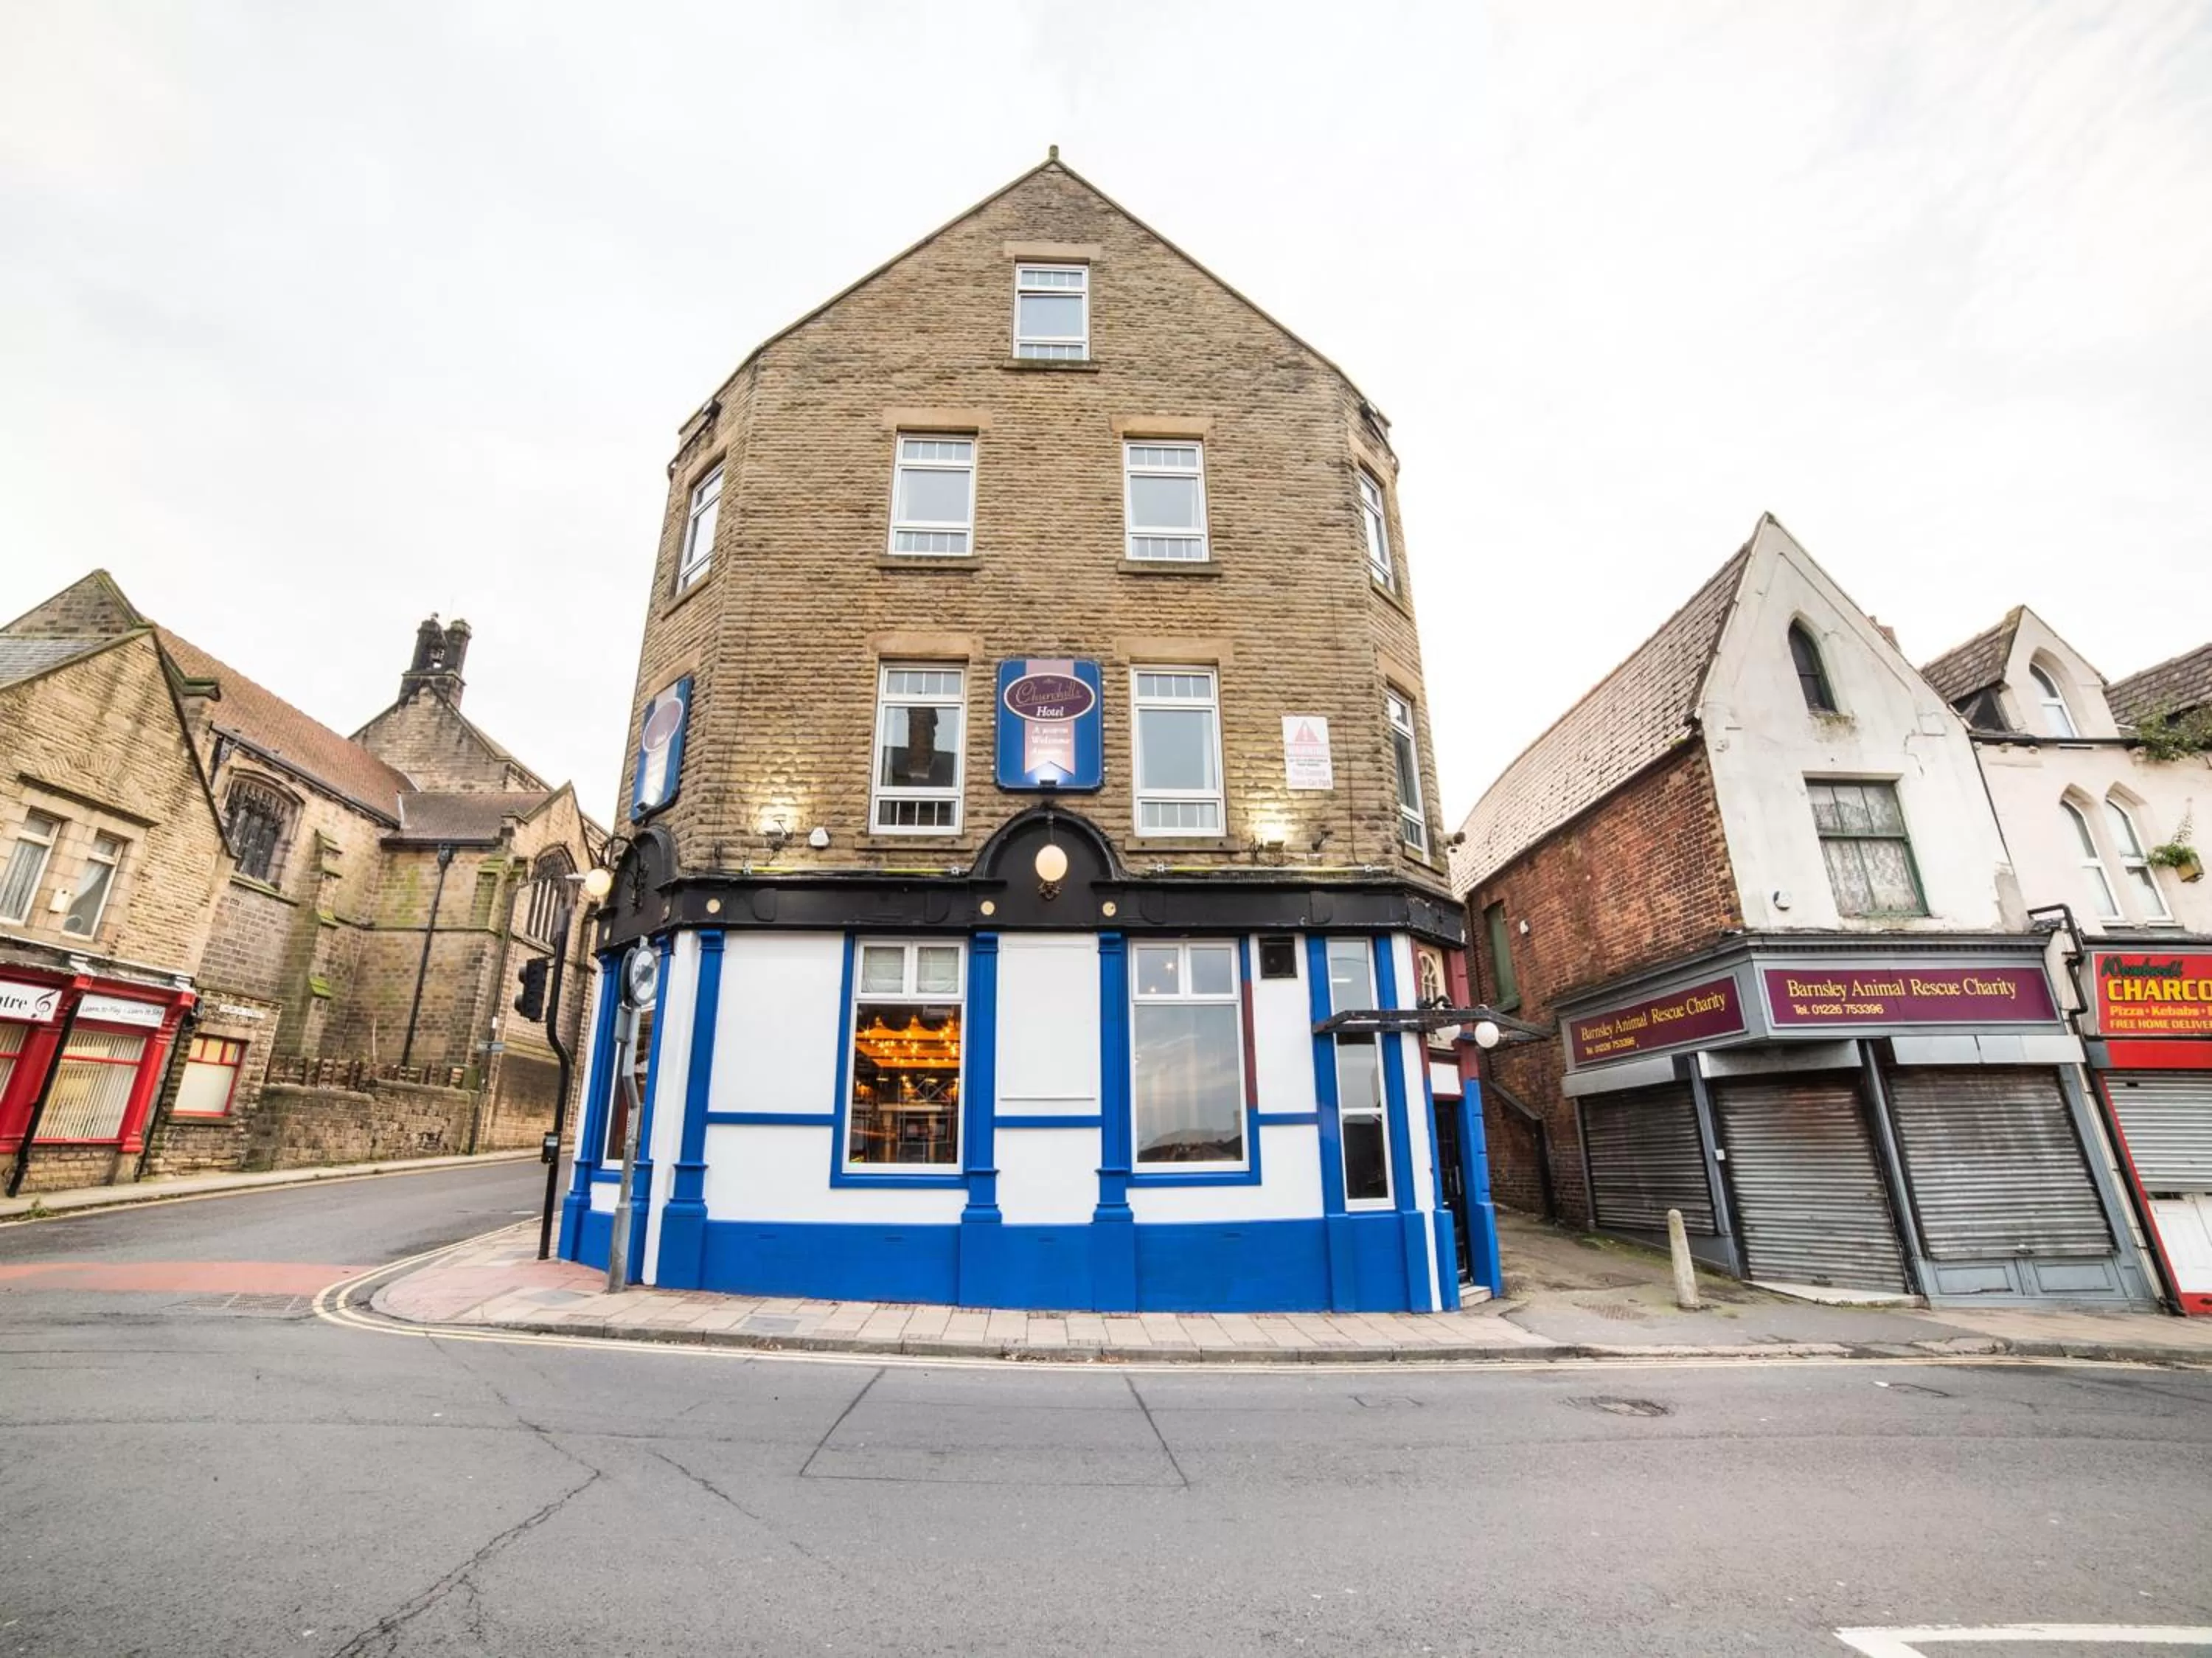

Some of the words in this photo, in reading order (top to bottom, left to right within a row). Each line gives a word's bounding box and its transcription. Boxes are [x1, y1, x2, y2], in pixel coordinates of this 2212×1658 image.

[1036, 706, 1064, 718] Hotel
[1787, 979, 1847, 1002] Barnsley
[1851, 979, 1906, 996] Animal
[1910, 979, 1961, 996] Rescue
[1963, 977, 2017, 1000] Charity
[2107, 979, 2212, 1002] CHARCO
[1793, 1004, 1810, 1016] Tel.
[1812, 1004, 1843, 1015] 01226
[1843, 1004, 1885, 1015] 753396
[2110, 1005, 2145, 1016] Pizza
[2151, 1005, 2199, 1016] Kebabs
[1581, 1022, 1613, 1041] Barnsley
[1615, 1012, 1647, 1033] Animal
[1652, 1006, 1685, 1024] Rescue
[1686, 992, 1726, 1016] Charity
[2110, 1019, 2137, 1029] FREE
[2138, 1019, 2171, 1029] HOME
